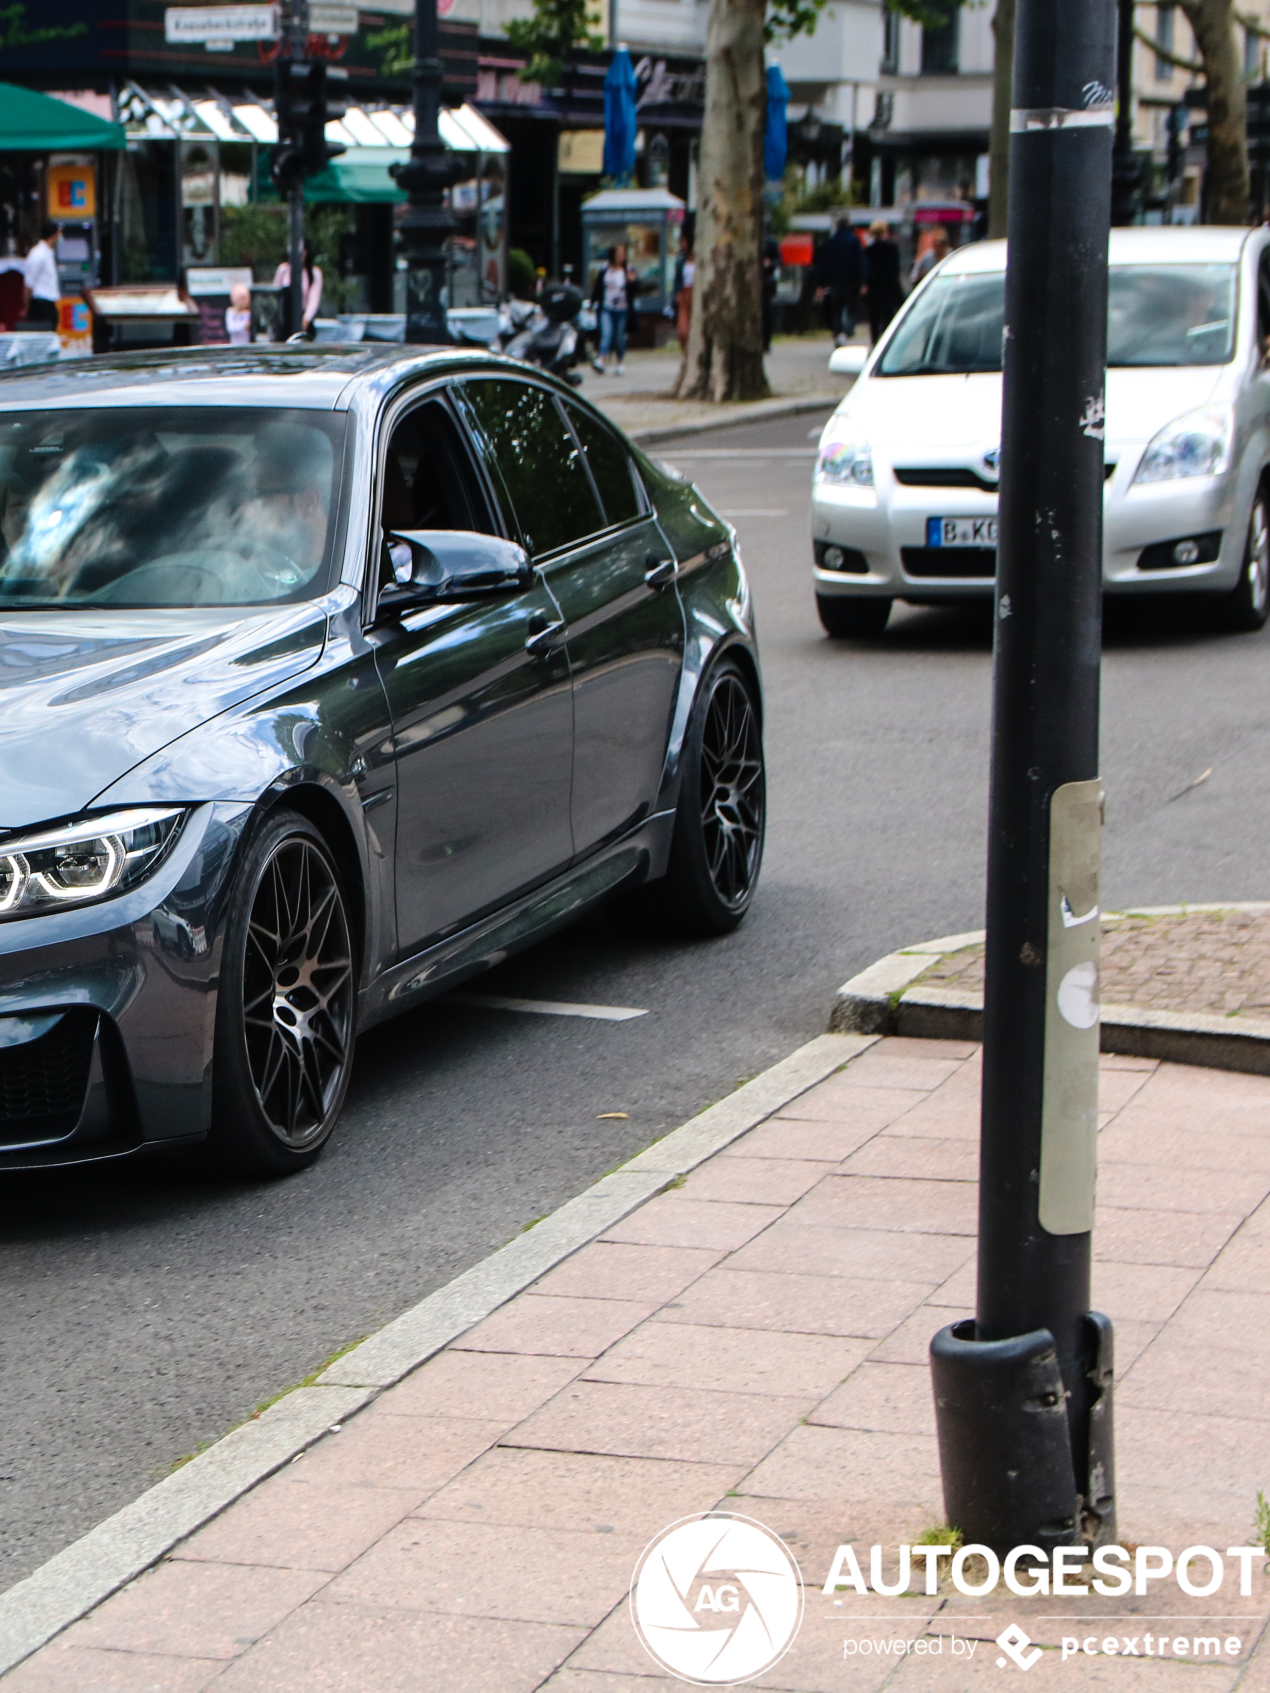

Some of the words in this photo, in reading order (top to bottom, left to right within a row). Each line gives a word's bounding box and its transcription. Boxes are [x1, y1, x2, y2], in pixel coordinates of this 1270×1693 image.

[58, 181, 86, 207] EC
[61, 304, 89, 331] EC
[944, 523, 956, 541] B
